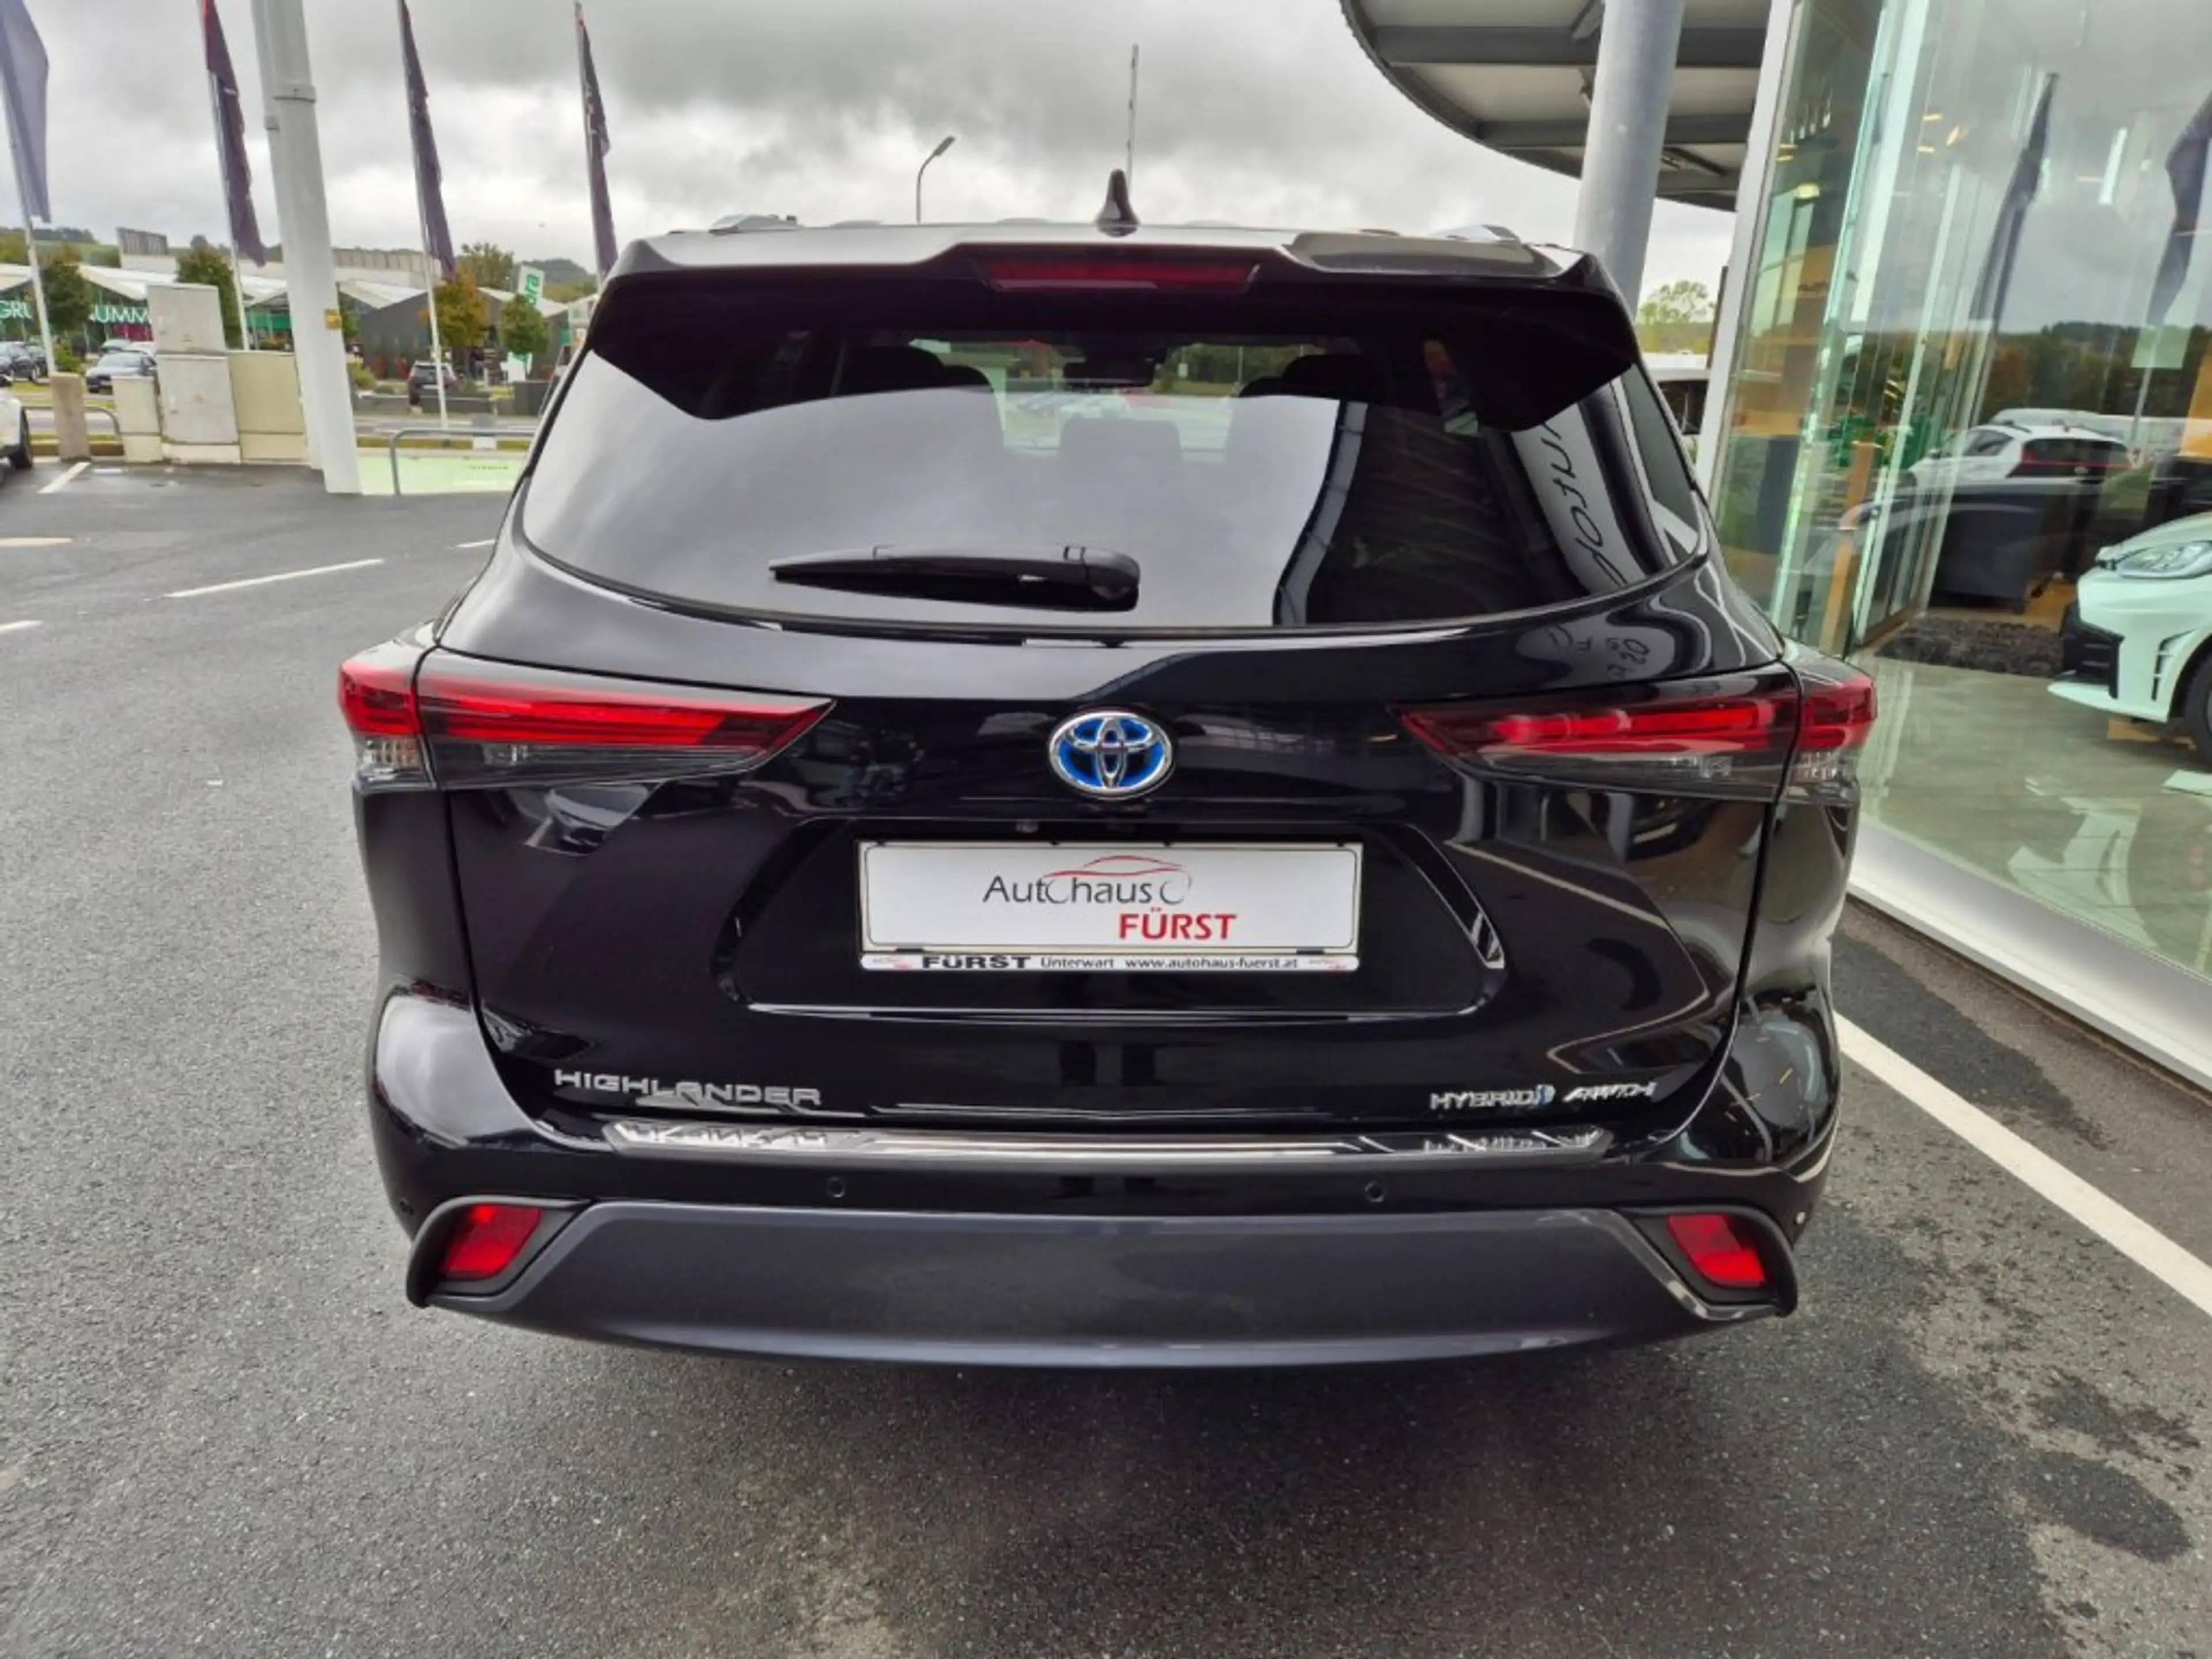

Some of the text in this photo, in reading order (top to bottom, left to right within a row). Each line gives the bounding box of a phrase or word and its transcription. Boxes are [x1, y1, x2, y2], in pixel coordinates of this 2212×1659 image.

[1119, 907, 1237, 940] FÜRST
[1040, 956, 1115, 969] Unterwart
[1124, 956, 1298, 969] www.autohaus-fuerst.at
[554, 1068, 823, 1105] HIGHLANDER
[1430, 1089, 1537, 1109] HYBRID
